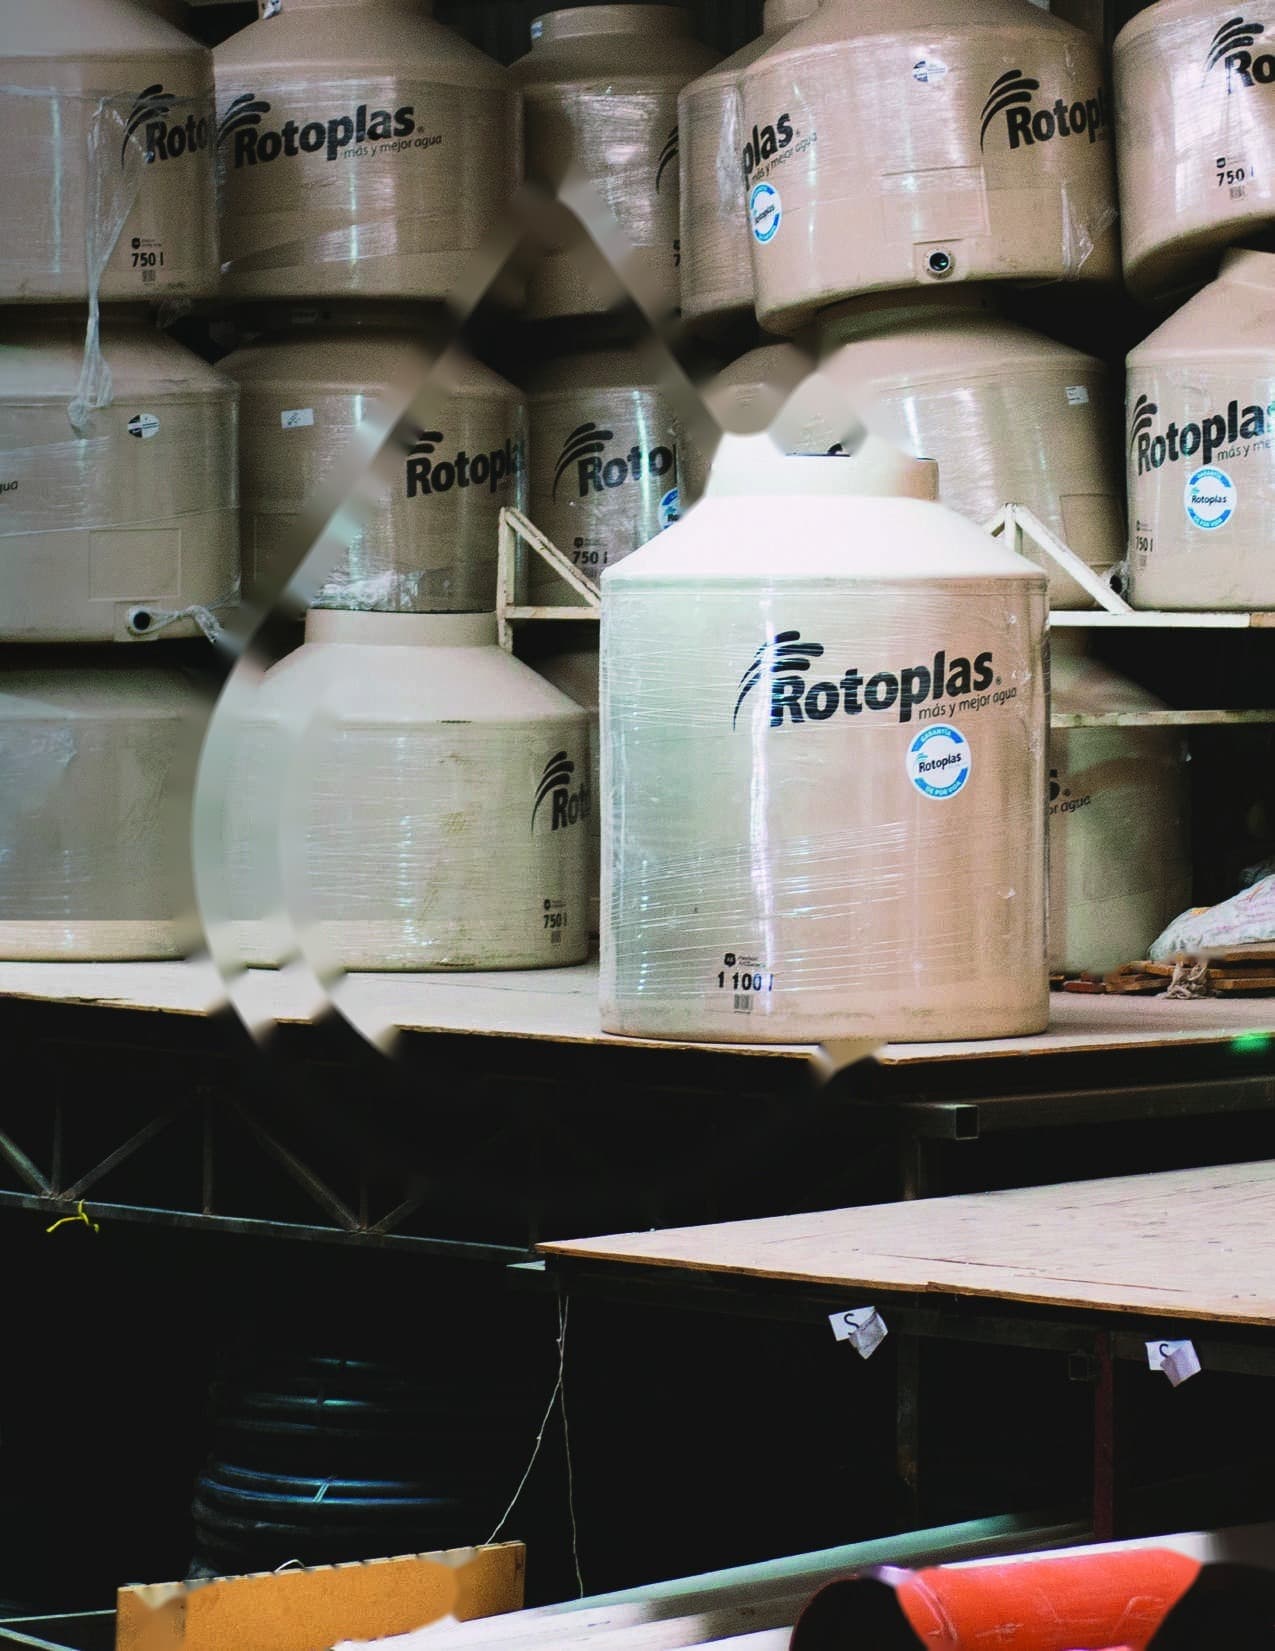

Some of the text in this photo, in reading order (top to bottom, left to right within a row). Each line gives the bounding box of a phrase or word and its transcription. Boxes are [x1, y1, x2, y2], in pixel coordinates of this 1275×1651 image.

[234, 104, 416, 168] Rotoplas
[414, 135, 442, 149] agua
[1216, 168, 1245, 187] 750
[131, 252, 156, 267] 750
[572, 551, 599, 565] 750
[770, 650, 994, 727] Rotoplas
[919, 687, 1017, 721] más y mejor agua
[918, 753, 962, 773] Rotoplas
[543, 912, 561, 928] 750
